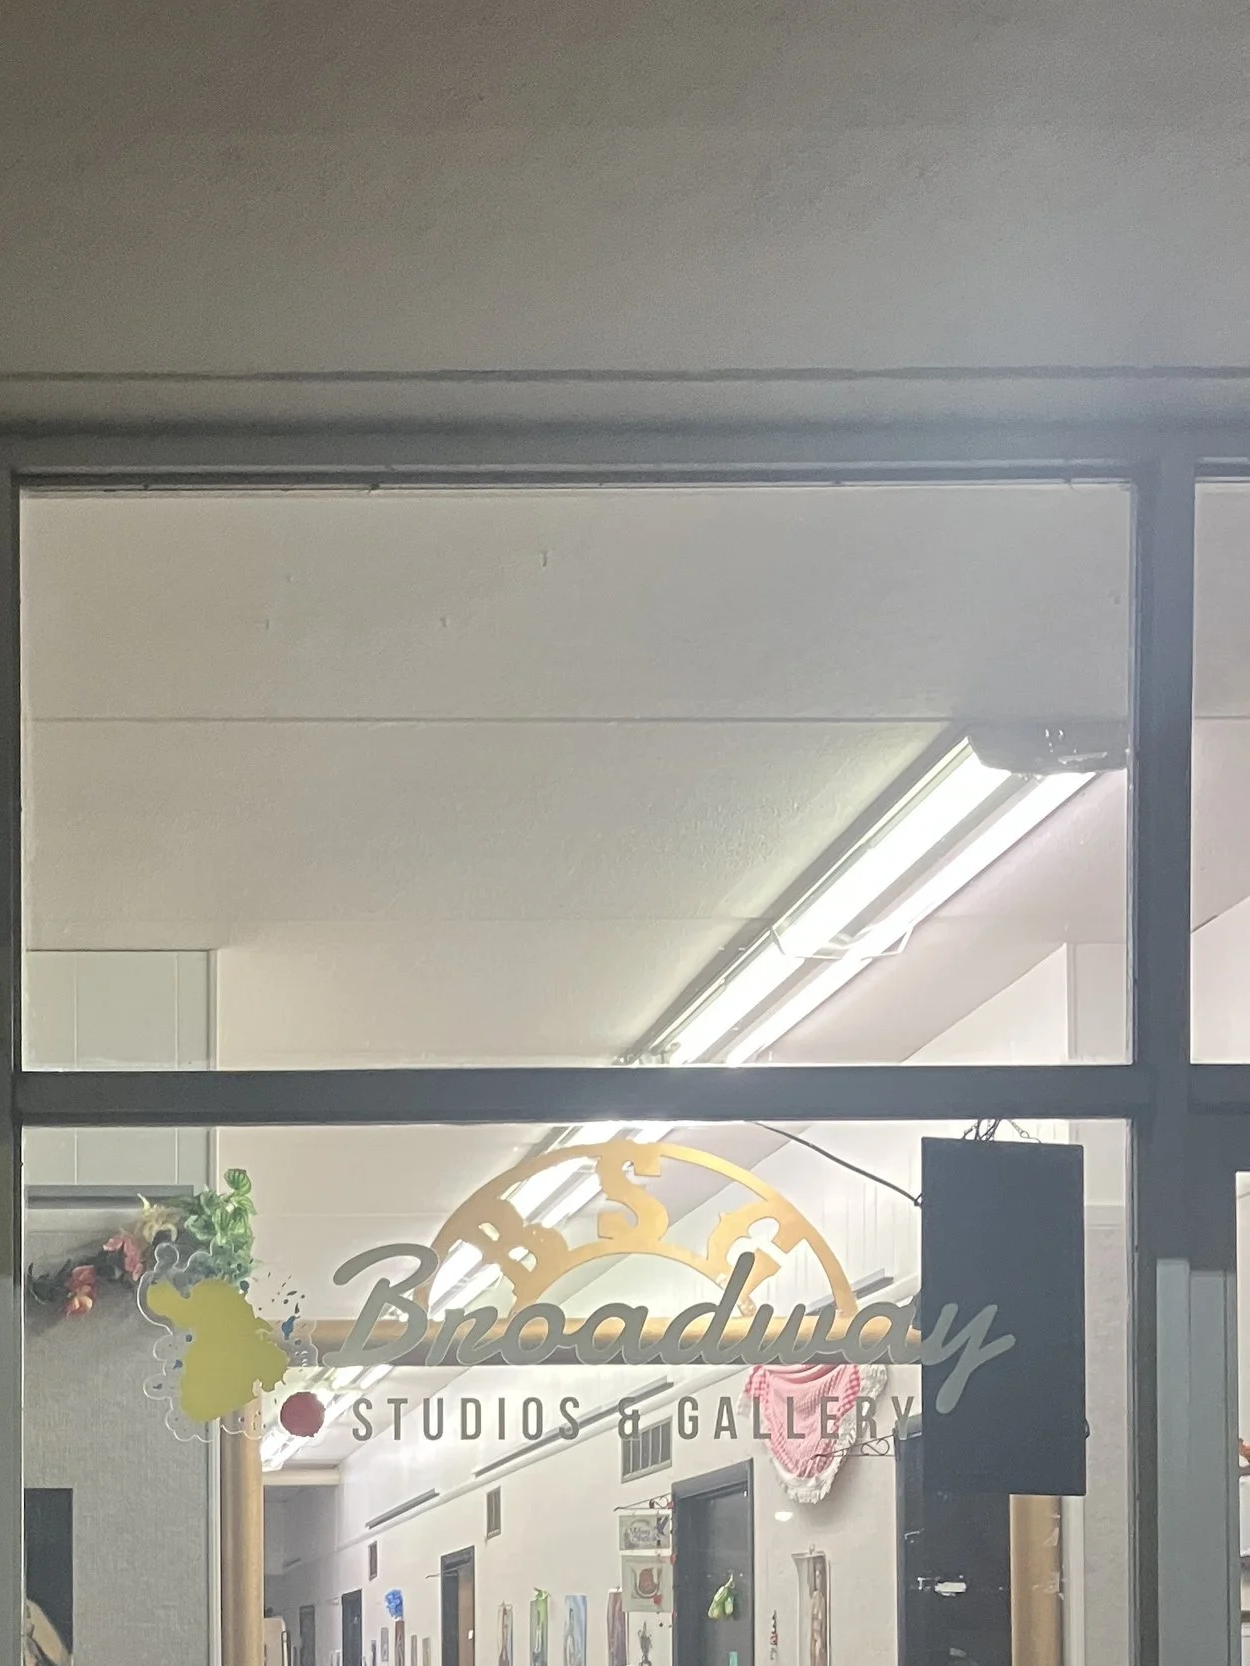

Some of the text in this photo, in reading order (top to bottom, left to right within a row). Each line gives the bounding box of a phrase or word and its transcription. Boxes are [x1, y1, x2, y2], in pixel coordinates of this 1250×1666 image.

[323, 1243, 1016, 1414] Broadway
[352, 1396, 914, 1441] STUDIOS & GALLERY
